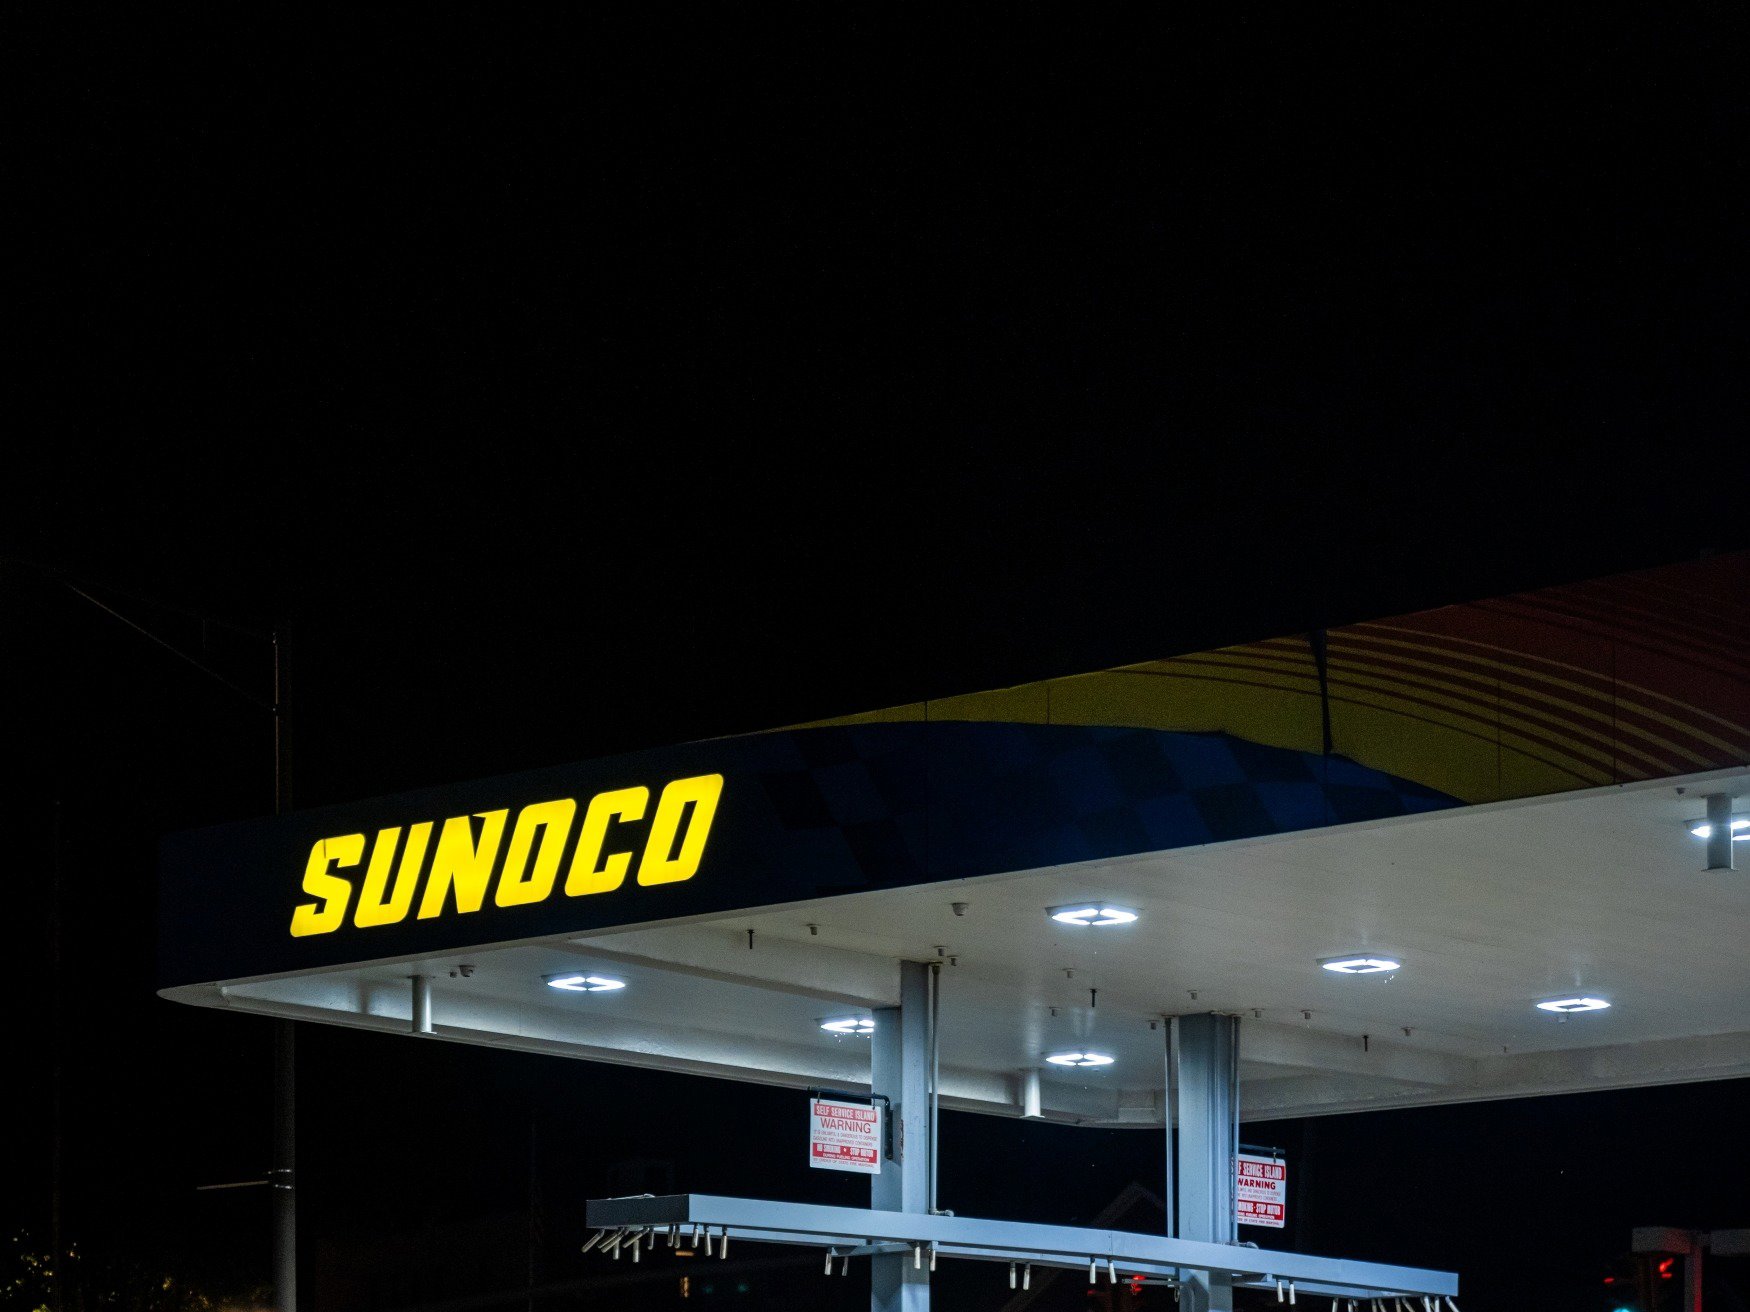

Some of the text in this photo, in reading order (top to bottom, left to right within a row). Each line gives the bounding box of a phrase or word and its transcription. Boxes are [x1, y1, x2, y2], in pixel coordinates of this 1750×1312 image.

[290, 773, 724, 937] SUNOCO
[816, 1105, 875, 1121] SELF SERVICE ISLAND
[820, 1117, 871, 1134] WARNING
[1243, 1162, 1263, 1177] SERVICE
[1265, 1165, 1282, 1180] ISLAND
